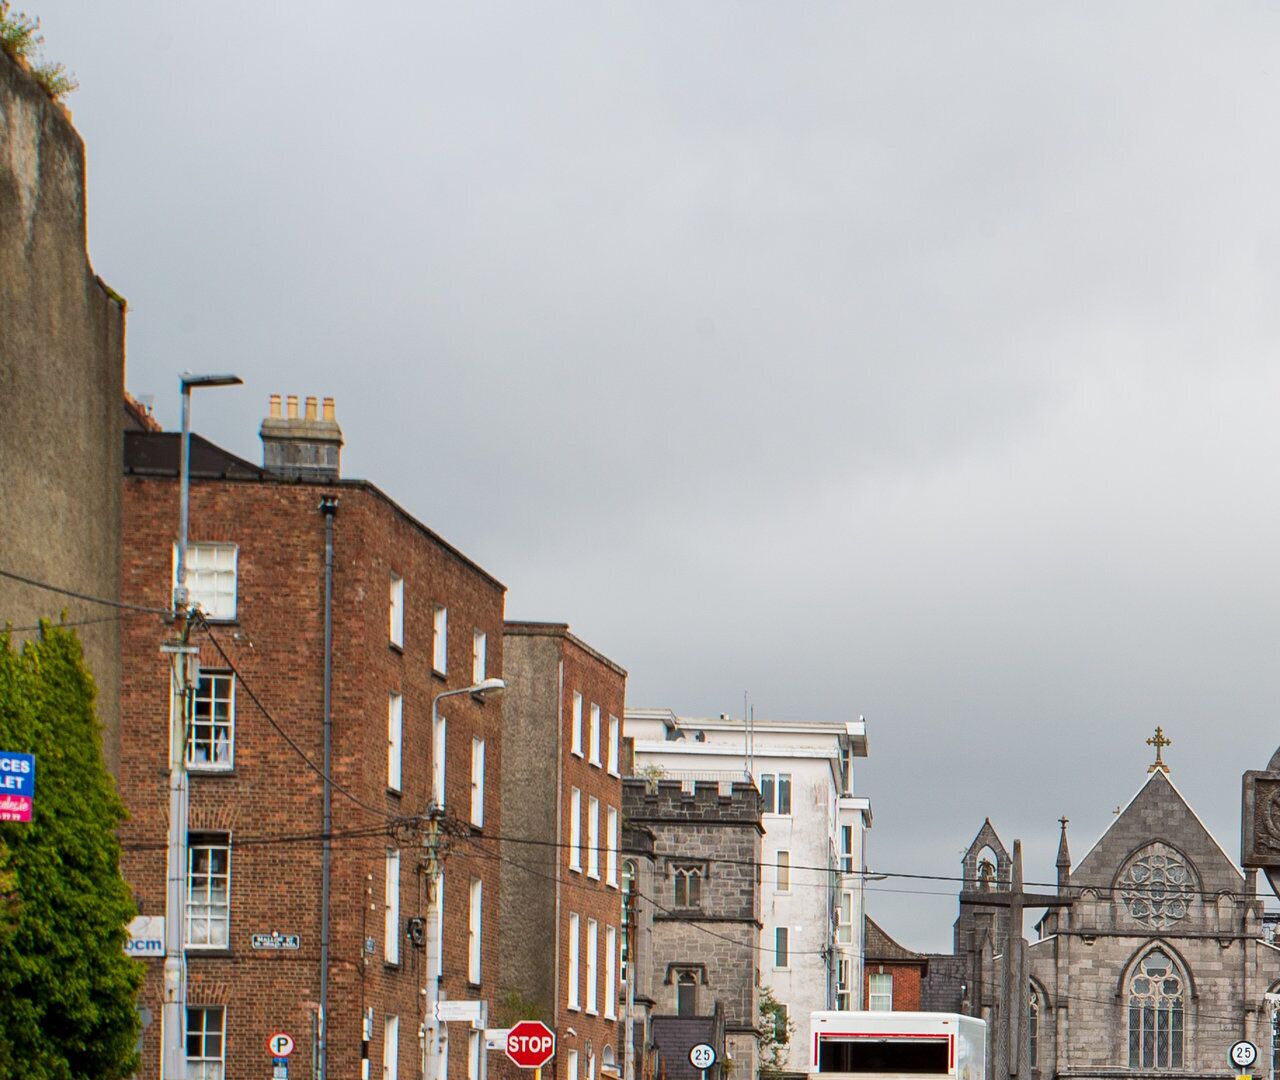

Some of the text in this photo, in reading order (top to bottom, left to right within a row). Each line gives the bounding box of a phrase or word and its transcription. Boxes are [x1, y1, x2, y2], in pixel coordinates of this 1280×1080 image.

[0, 758, 30, 773] CES
[277, 1037, 288, 1053] P
[508, 1036, 552, 1053] STOP
[695, 1049, 711, 1060] 25
[1237, 1047, 1251, 1058] 25
